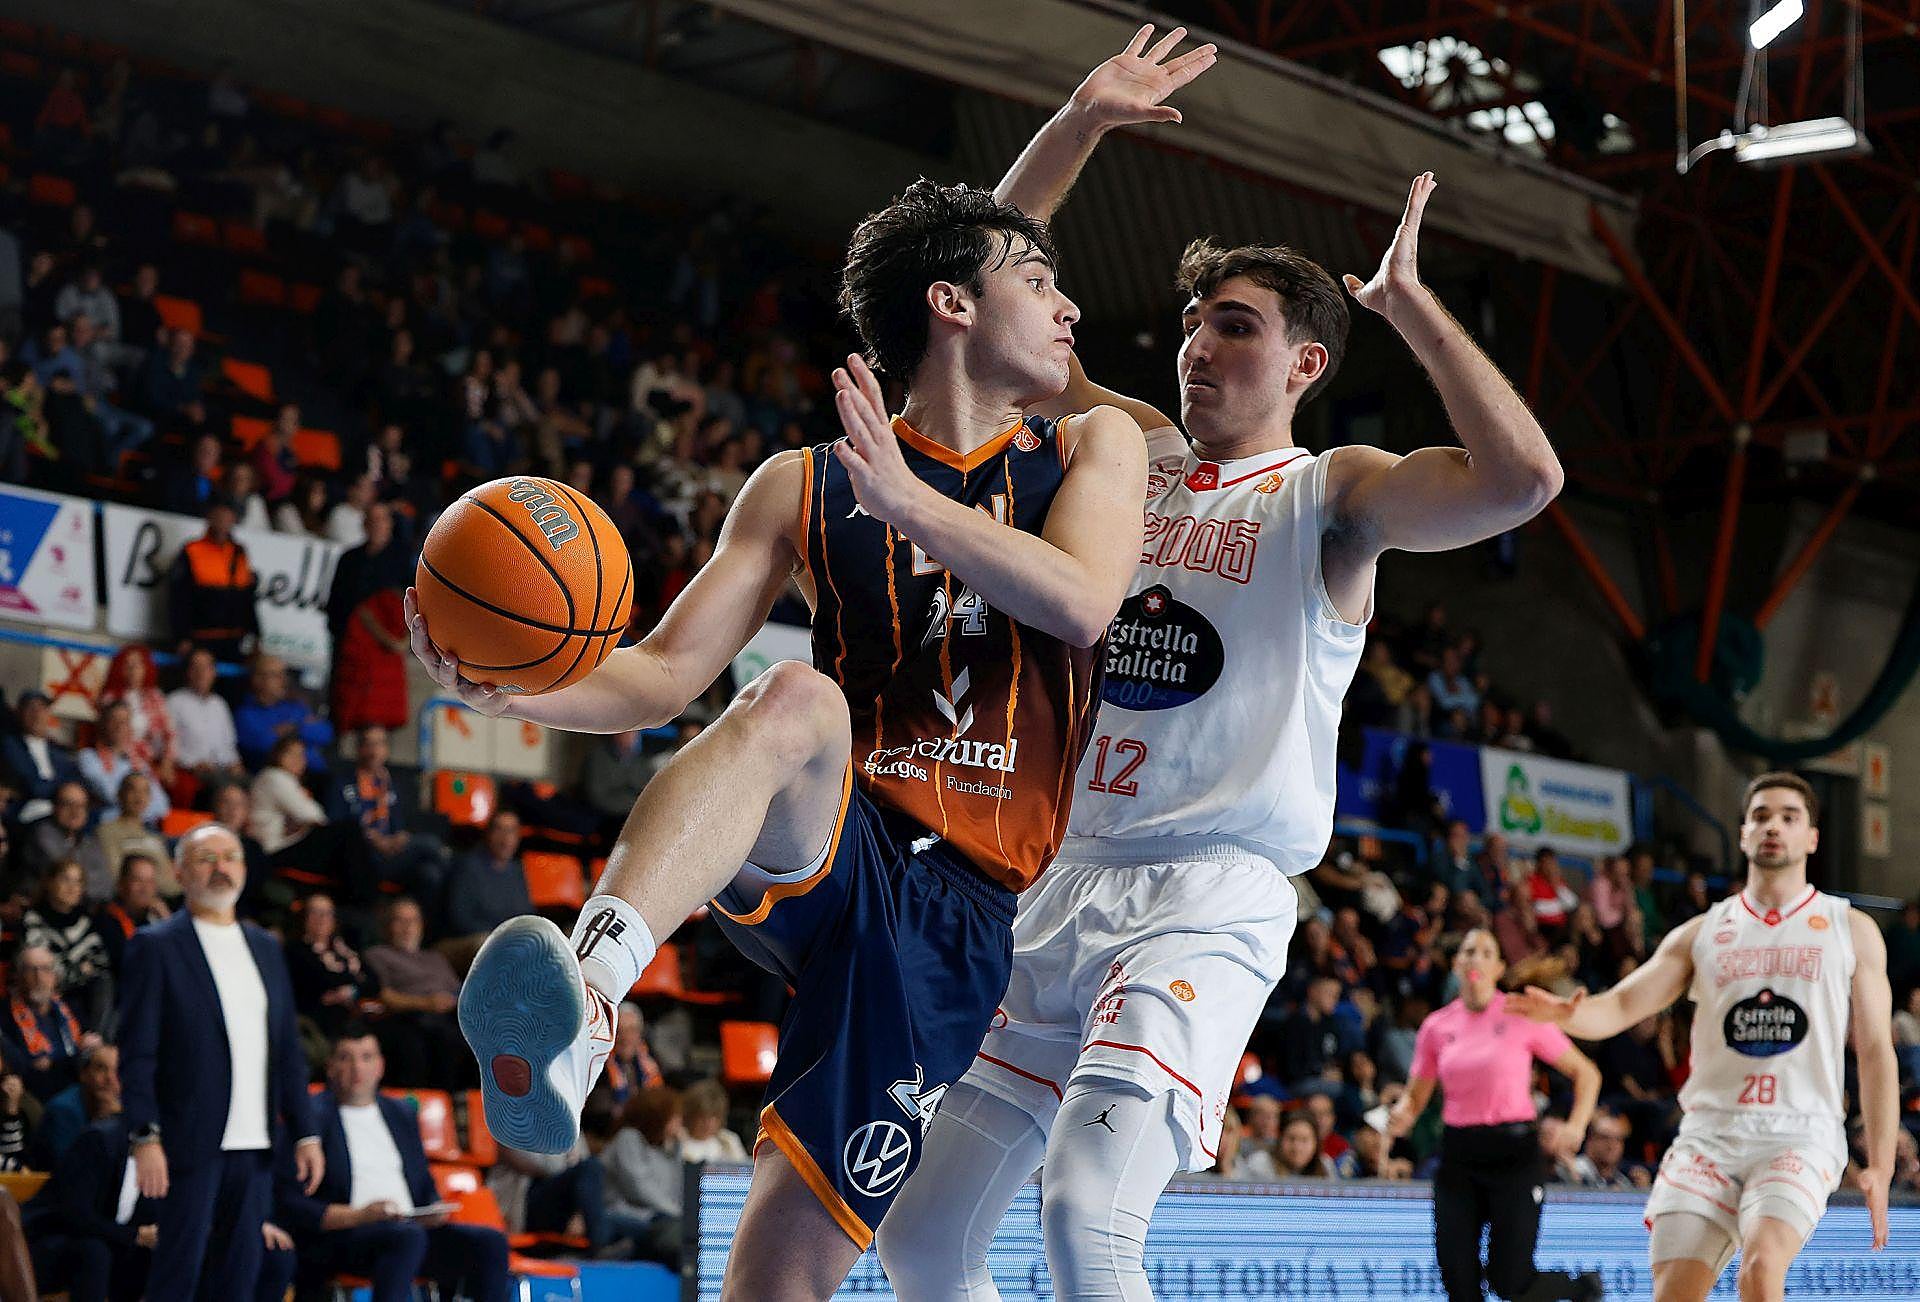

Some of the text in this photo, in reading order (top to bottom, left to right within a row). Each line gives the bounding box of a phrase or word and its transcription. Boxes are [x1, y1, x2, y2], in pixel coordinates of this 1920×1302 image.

[1108, 617, 1199, 655] Estrella
[1087, 735, 1148, 798] 12
[946, 775, 1013, 800] Fundación
[1733, 1006, 1796, 1026] Estrella
[1737, 1073, 1778, 1106] 28
